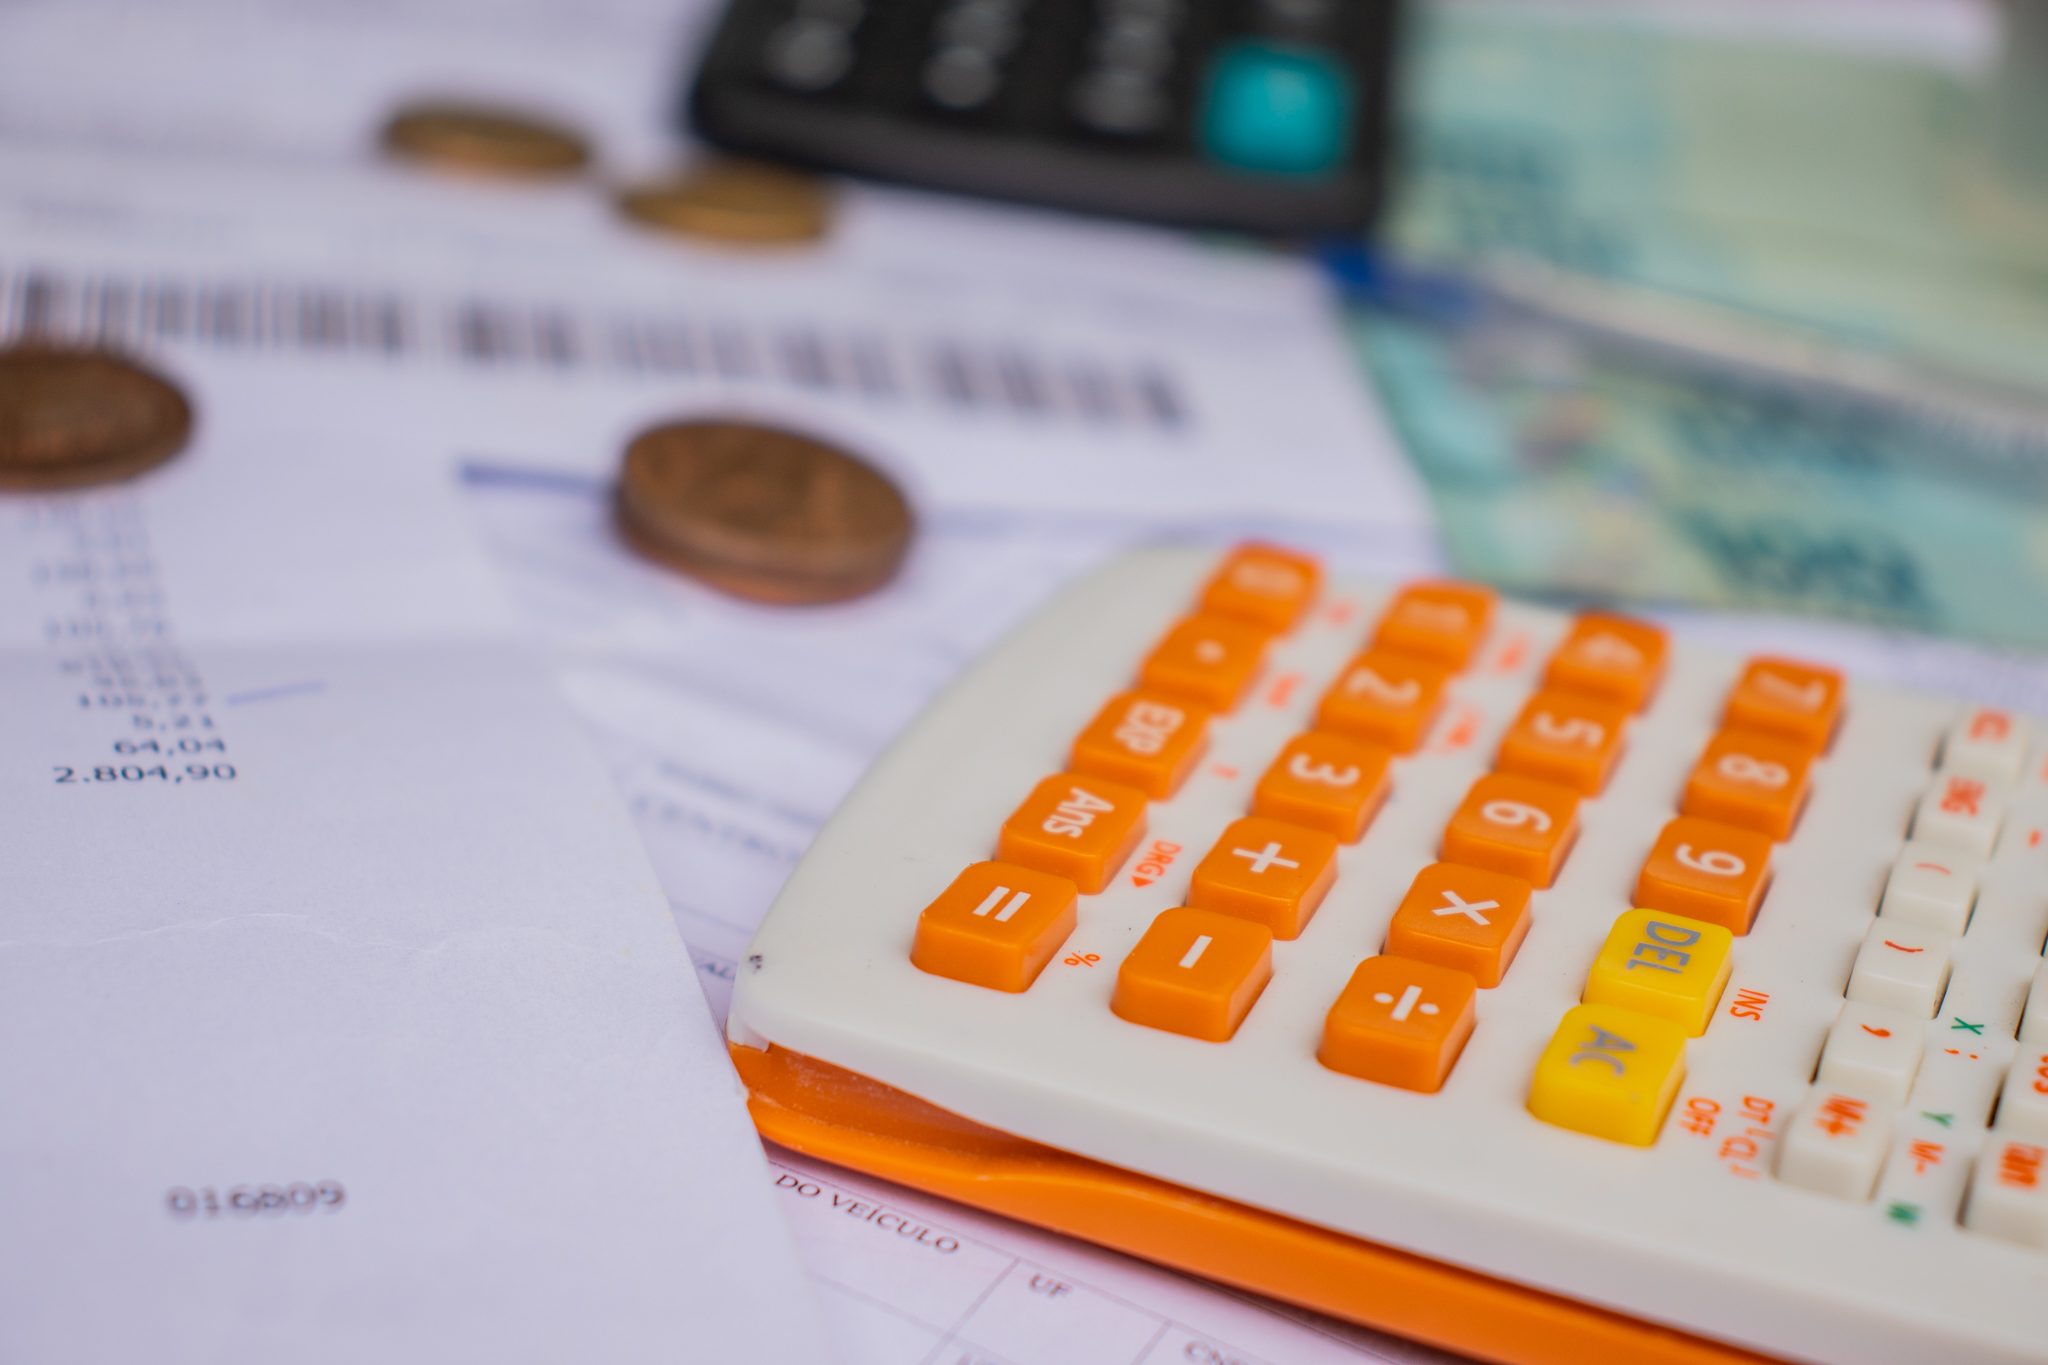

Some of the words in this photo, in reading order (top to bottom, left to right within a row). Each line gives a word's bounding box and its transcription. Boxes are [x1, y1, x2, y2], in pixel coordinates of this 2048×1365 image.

[1348, 665, 1421, 702] 2
[1533, 710, 1606, 747] 5
[113, 737, 227, 756] 64,04
[53, 762, 238, 784] 2.804,90
[1289, 752, 1361, 787] 3
[1716, 752, 1790, 786] 8
[1042, 786, 1115, 838] Ans
[1482, 800, 1552, 833] 6
[1675, 843, 1746, 876] 9
[1063, 951, 1101, 968] %
[1626, 920, 1702, 974] DEL
[1729, 988, 1770, 1021] INS
[1951, 1016, 1985, 1036] X
[1568, 1023, 1638, 1079] AC
[1679, 1097, 1722, 1137] OFF
[775, 1172, 821, 1198] DO
[829, 1192, 960, 1255] VEÍCULO
[1028, 1272, 1073, 1299] UF
